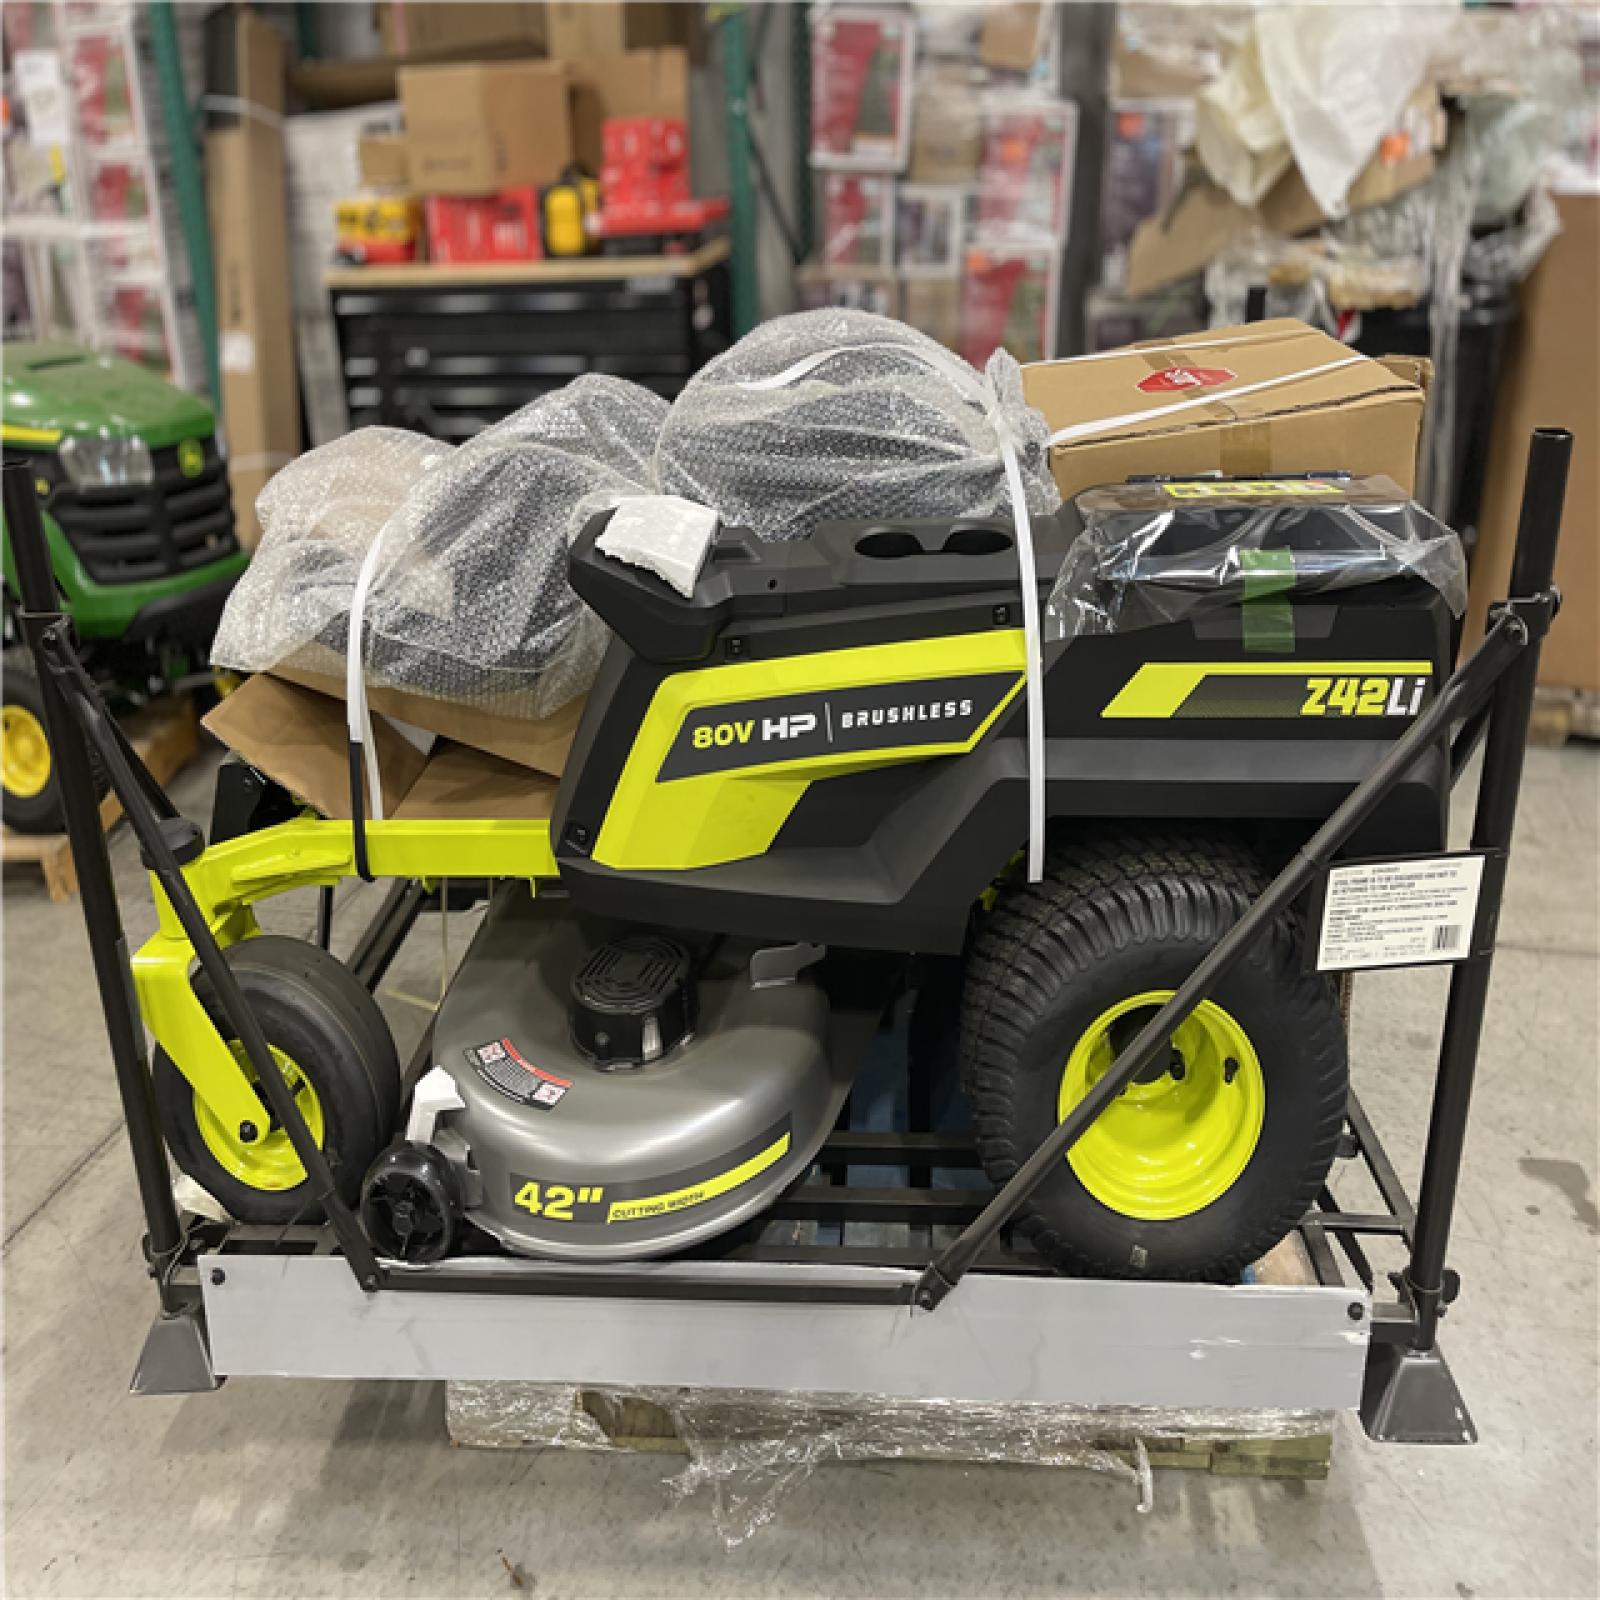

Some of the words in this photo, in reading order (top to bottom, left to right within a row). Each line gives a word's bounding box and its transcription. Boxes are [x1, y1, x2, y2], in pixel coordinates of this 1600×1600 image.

[1301, 679, 1426, 716] Z42Li
[692, 721, 755, 749] 80V
[762, 714, 818, 742] HP
[841, 699, 974, 729] BRUSHLESS
[514, 1182, 604, 1220] 42"
[613, 1203, 665, 1219] CUTTING
